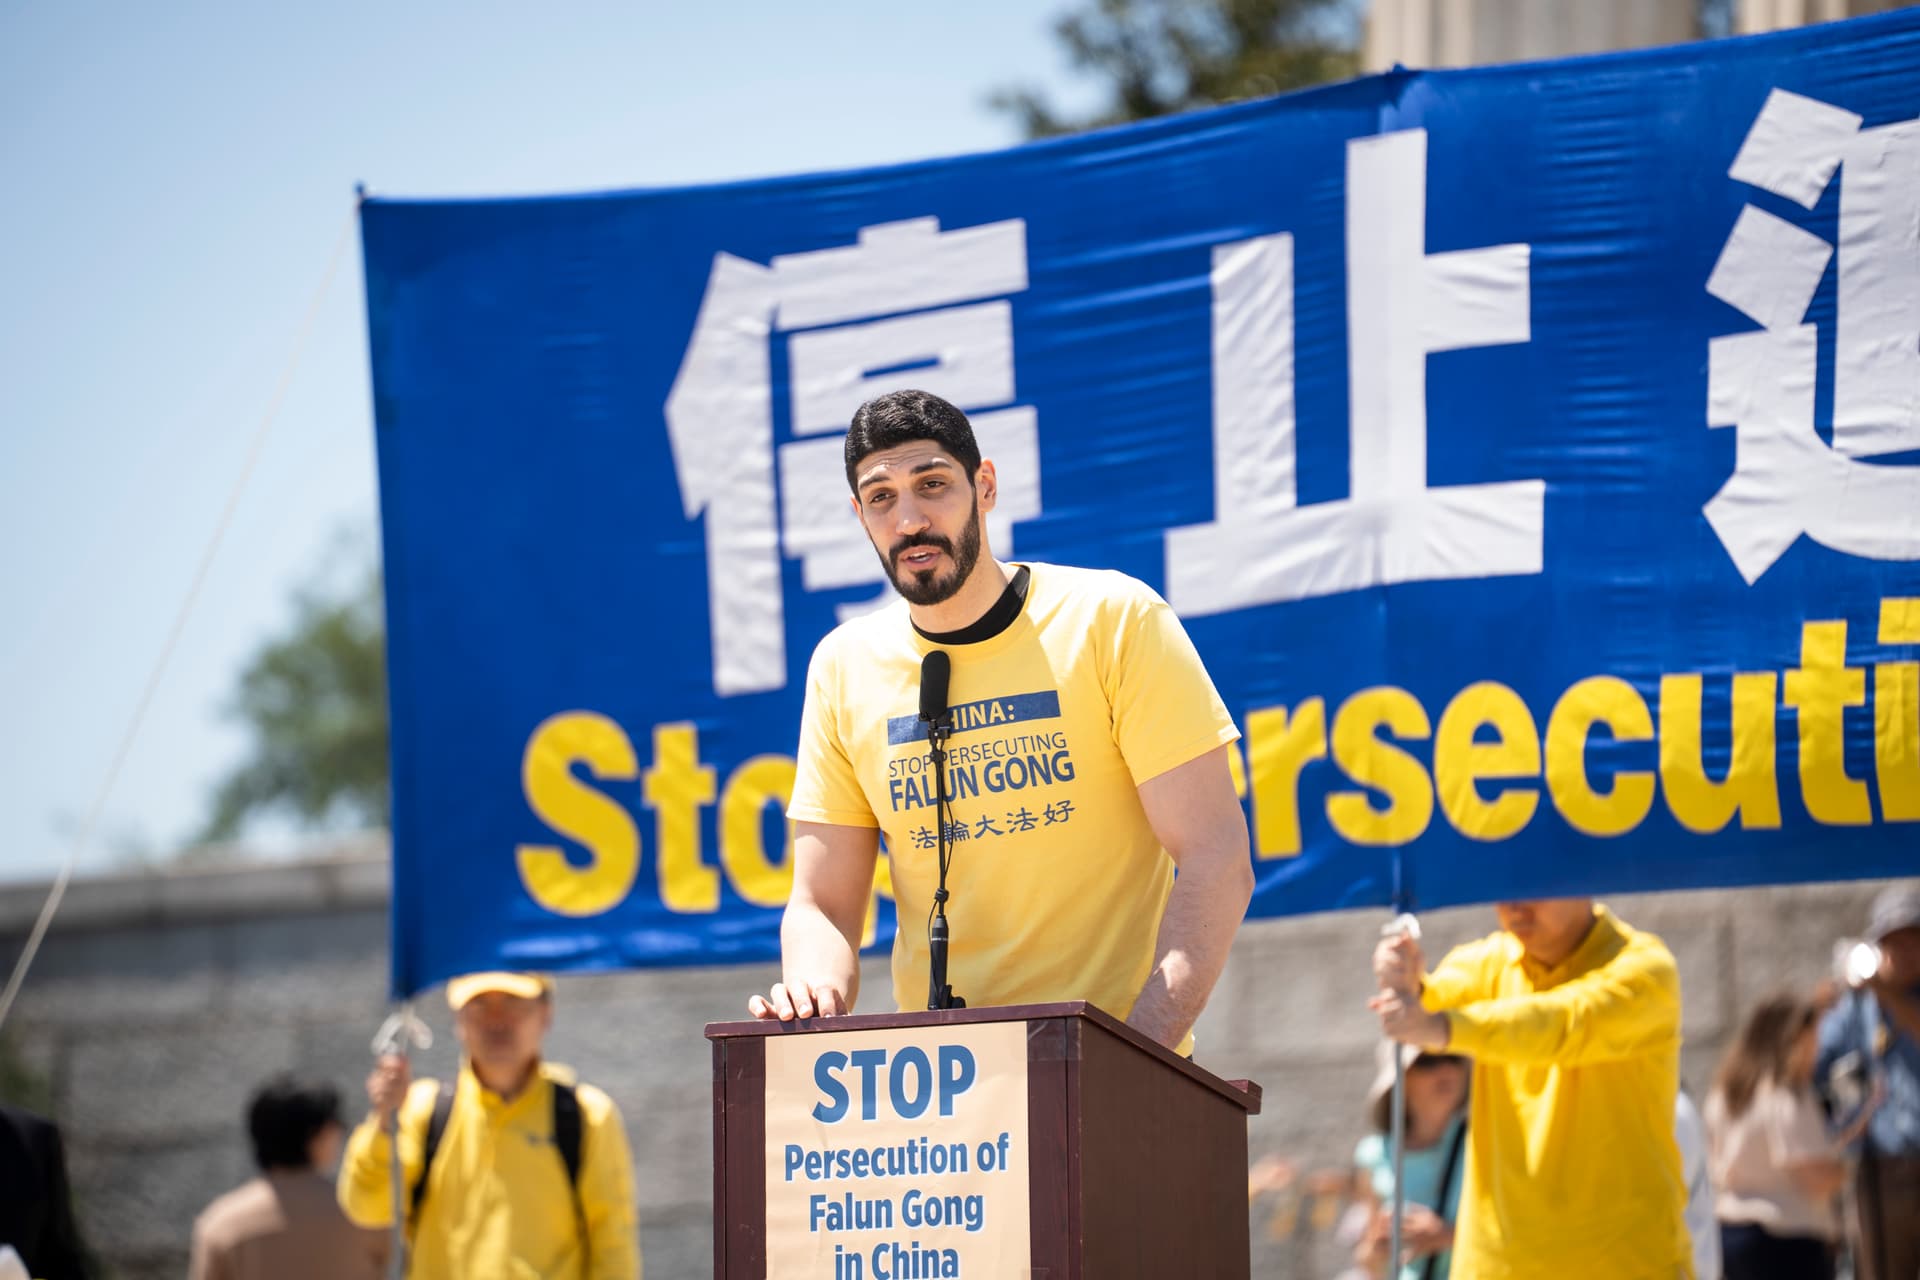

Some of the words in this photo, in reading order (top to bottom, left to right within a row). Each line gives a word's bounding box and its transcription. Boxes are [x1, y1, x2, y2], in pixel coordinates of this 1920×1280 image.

[516, 710, 896, 948] Sto
[1227, 597, 1920, 860] rsecuti
[889, 755, 932, 777] STOP
[983, 750, 1075, 793] GONG
[812, 1045, 976, 1123] STOP
[785, 1137, 968, 1181] Persecution
[977, 1132, 1009, 1171] of
[810, 1192, 893, 1232] Falun
[901, 1189, 984, 1232] Gong
[835, 1244, 863, 1280] in
[872, 1241, 959, 1280] China
